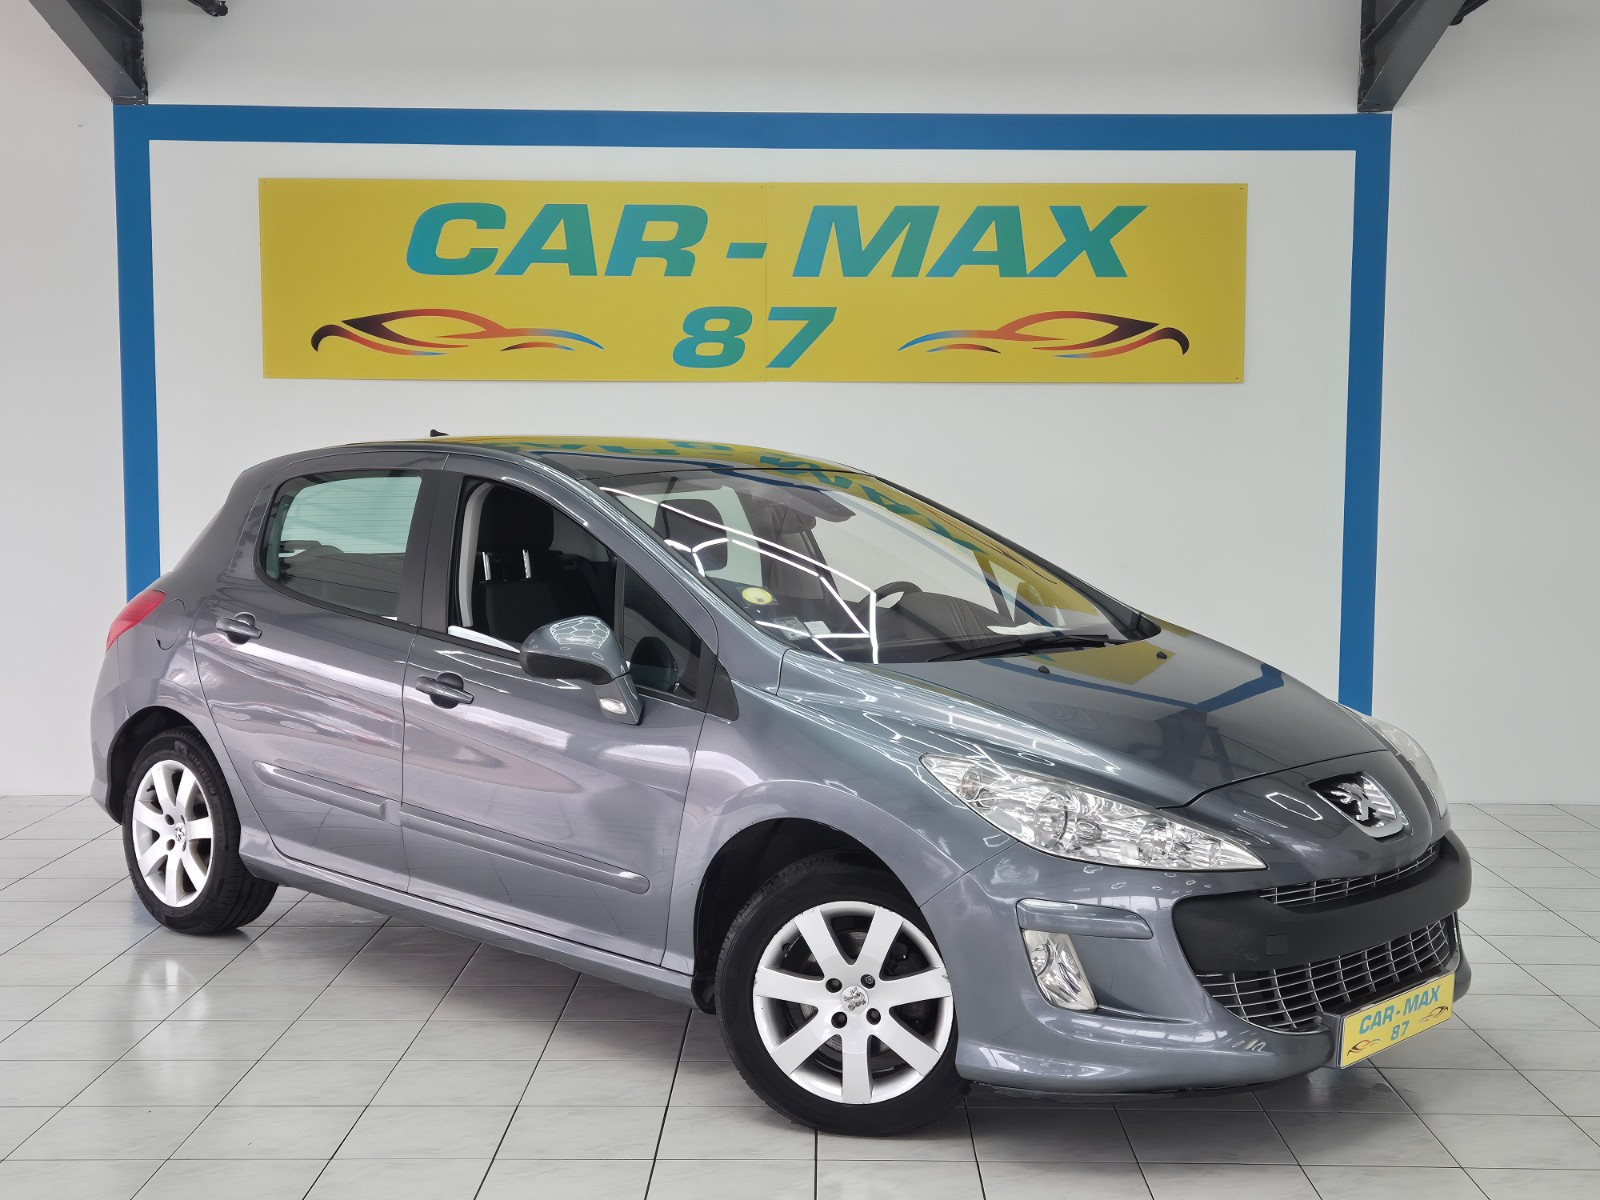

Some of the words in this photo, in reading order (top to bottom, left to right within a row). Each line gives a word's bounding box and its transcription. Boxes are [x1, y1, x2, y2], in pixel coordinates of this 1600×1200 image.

[406, 202, 708, 277] CAR
[793, 204, 1148, 279] MAX
[672, 306, 837, 369] 87
[1359, 1004, 1395, 1035] CAR
[1403, 984, 1441, 1017] MAX
[1390, 1020, 1410, 1041] 87
